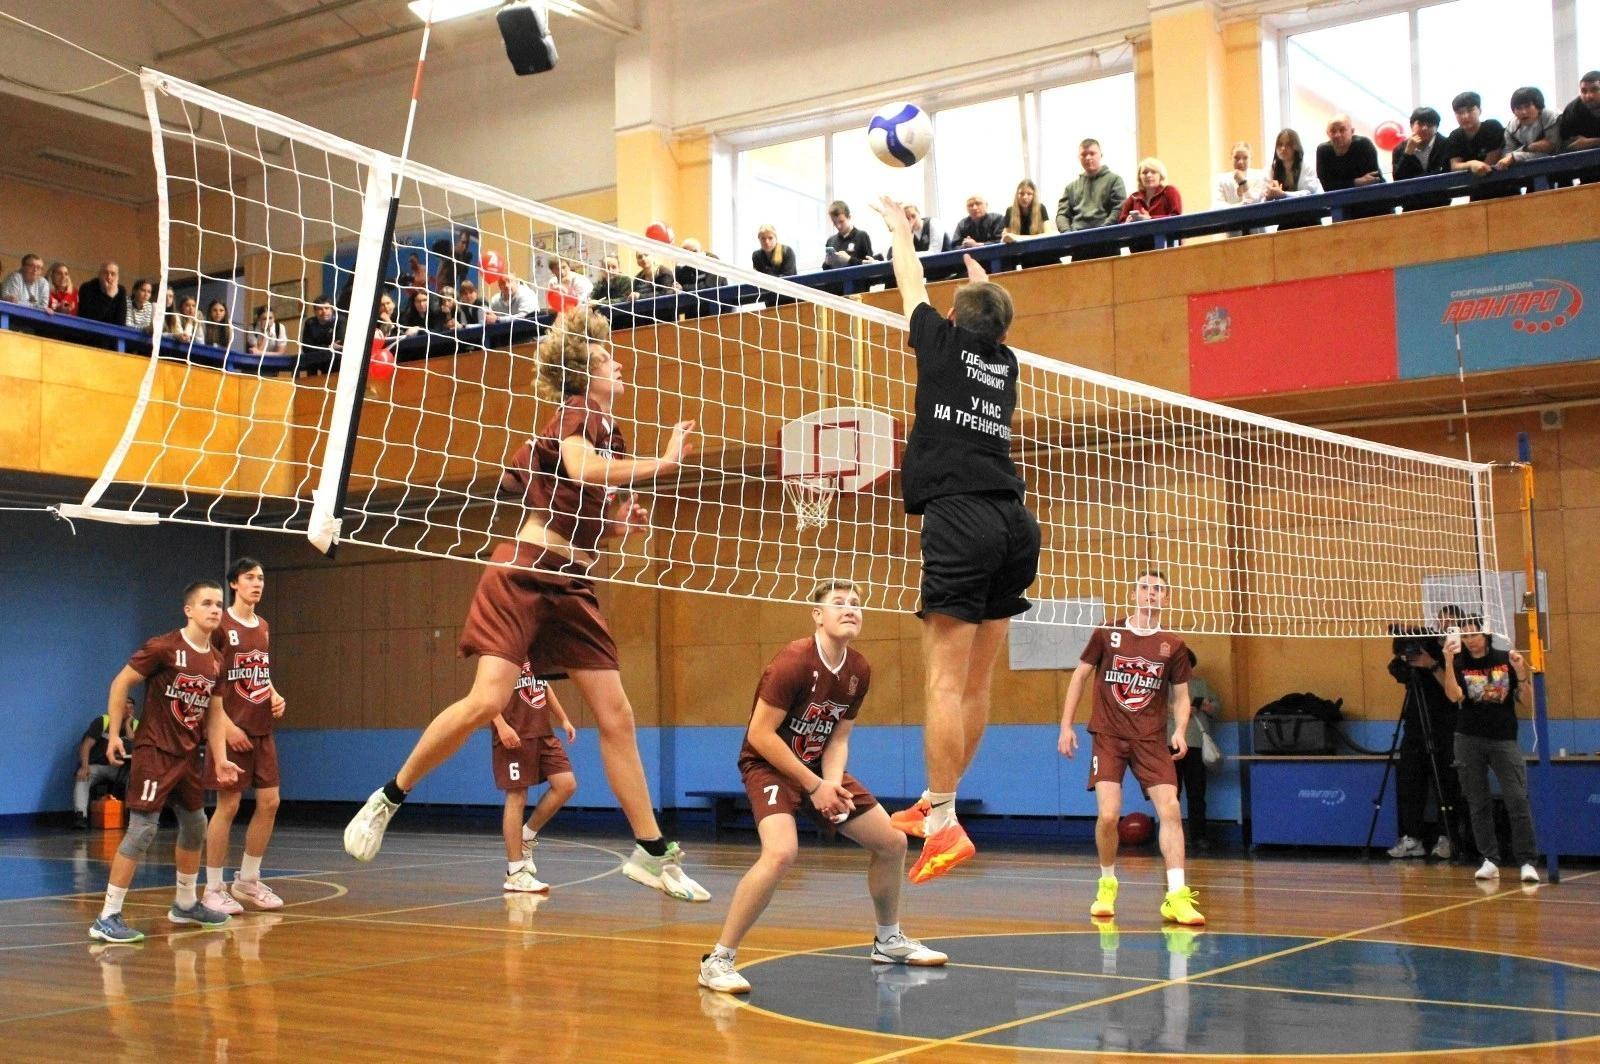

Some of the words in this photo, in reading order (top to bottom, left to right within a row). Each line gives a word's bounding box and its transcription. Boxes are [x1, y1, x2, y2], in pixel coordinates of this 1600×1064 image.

[961, 350, 980, 366] ГДЕ
[966, 366, 1005, 391] ТУСОВКИ?
[934, 404, 951, 421] НА
[971, 396, 980, 410] У
[982, 399, 1002, 419] НАС
[228, 629, 240, 646] 8
[1110, 631, 1122, 648] 9
[175, 649, 187, 668] 11
[509, 762, 520, 780] 6
[1092, 755, 1099, 775] 9
[141, 779, 157, 801] 11
[763, 784, 779, 805] 7
